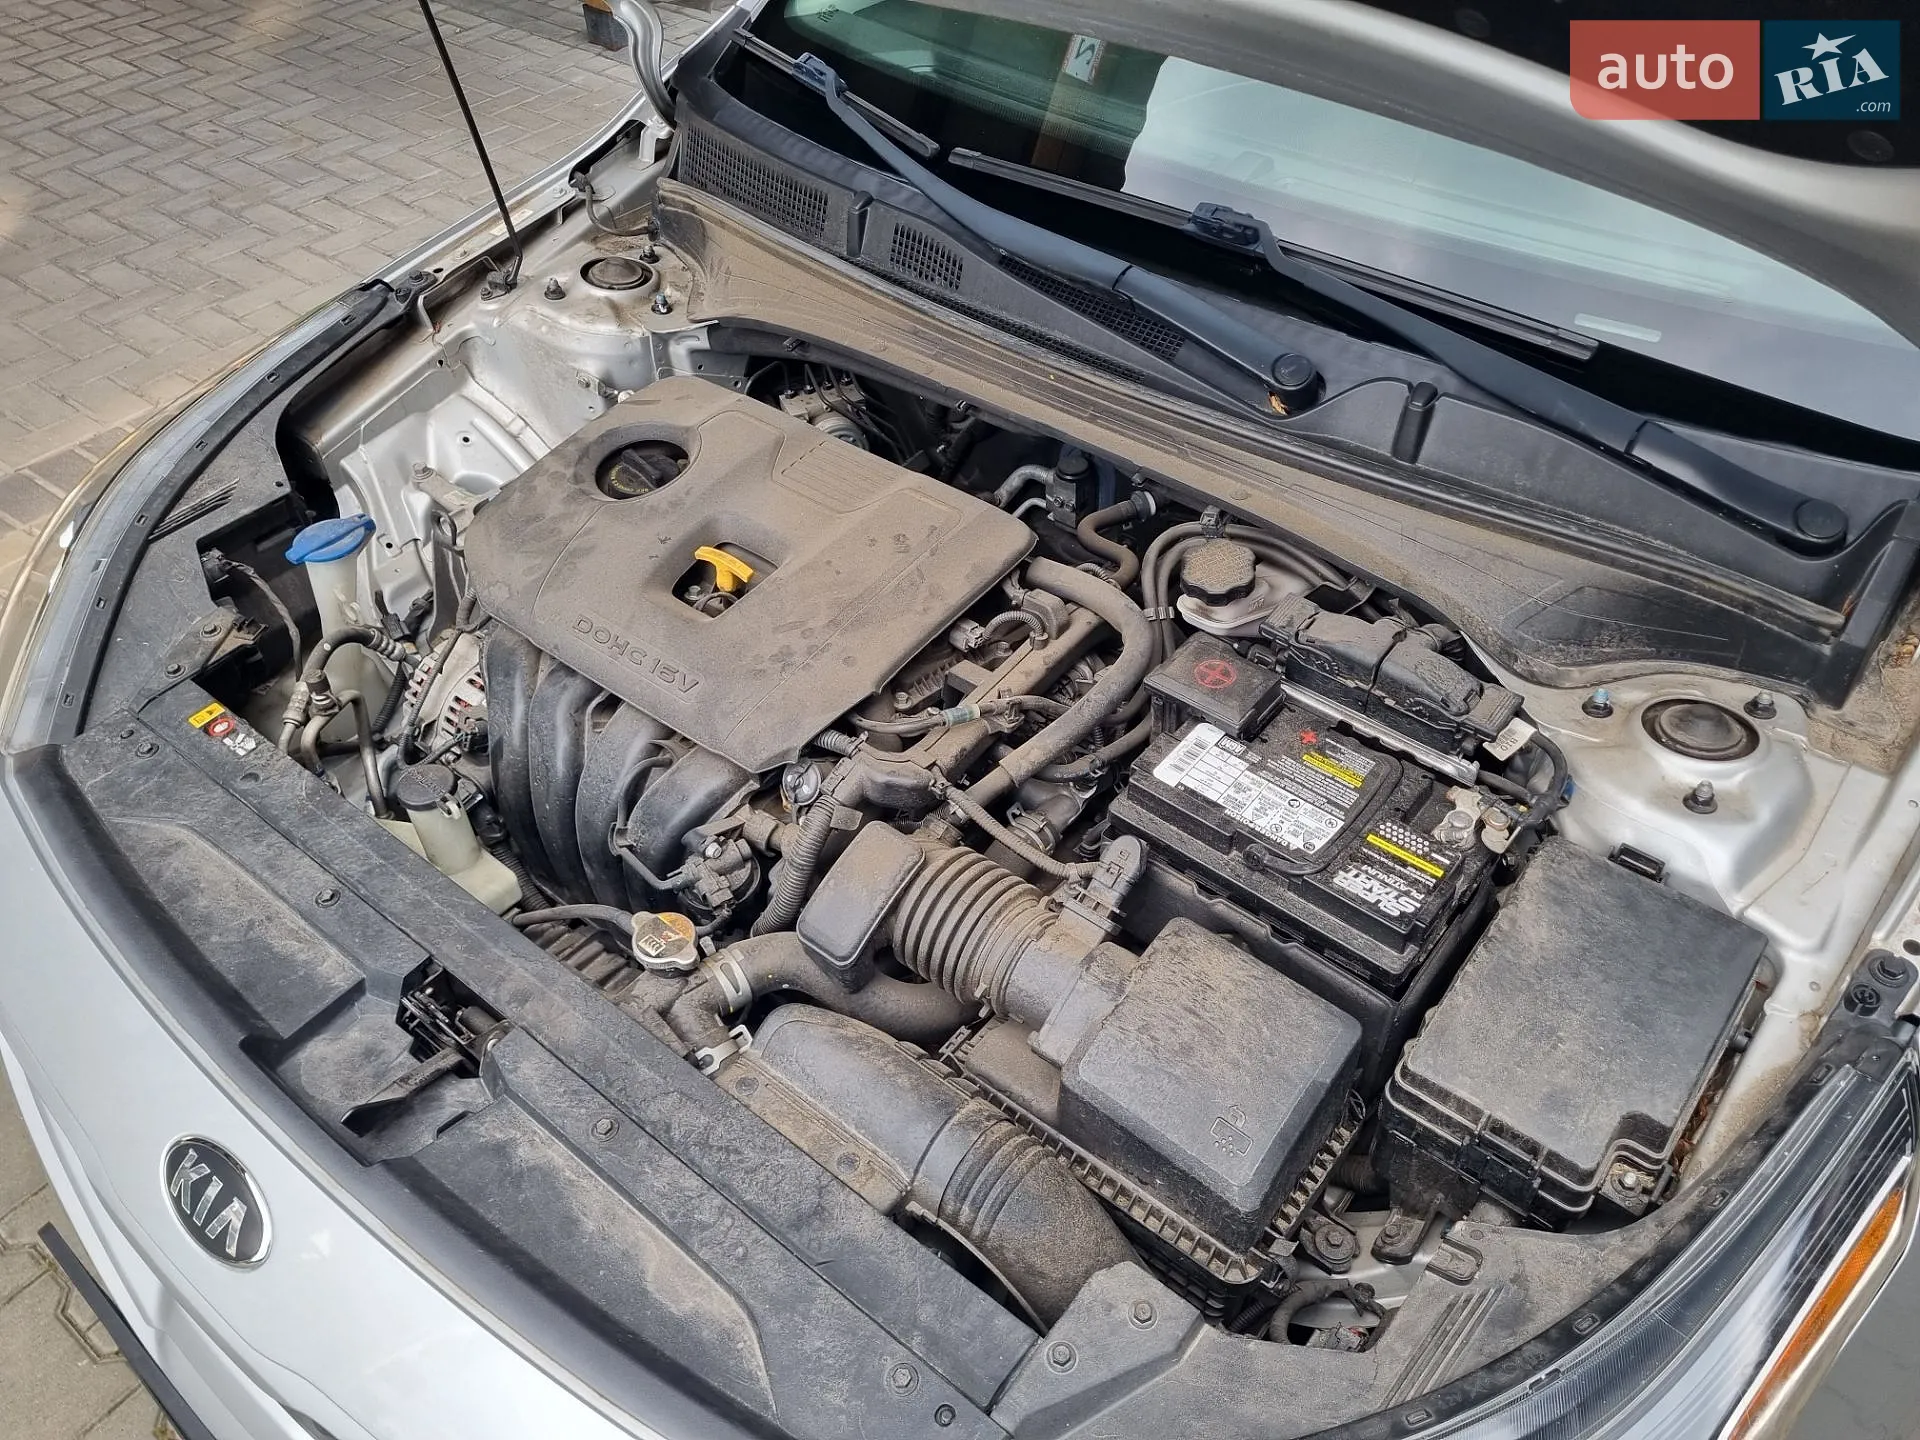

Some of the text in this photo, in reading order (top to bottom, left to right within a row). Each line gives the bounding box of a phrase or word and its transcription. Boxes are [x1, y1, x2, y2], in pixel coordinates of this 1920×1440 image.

[572, 615, 700, 694] DOHC 16V
[1218, 735, 1244, 754] AGM
[1331, 873, 1402, 916] SUPER
[1337, 866, 1421, 914] START
[1360, 863, 1425, 899] PLATINUM
[170, 1147, 248, 1258] KIA
